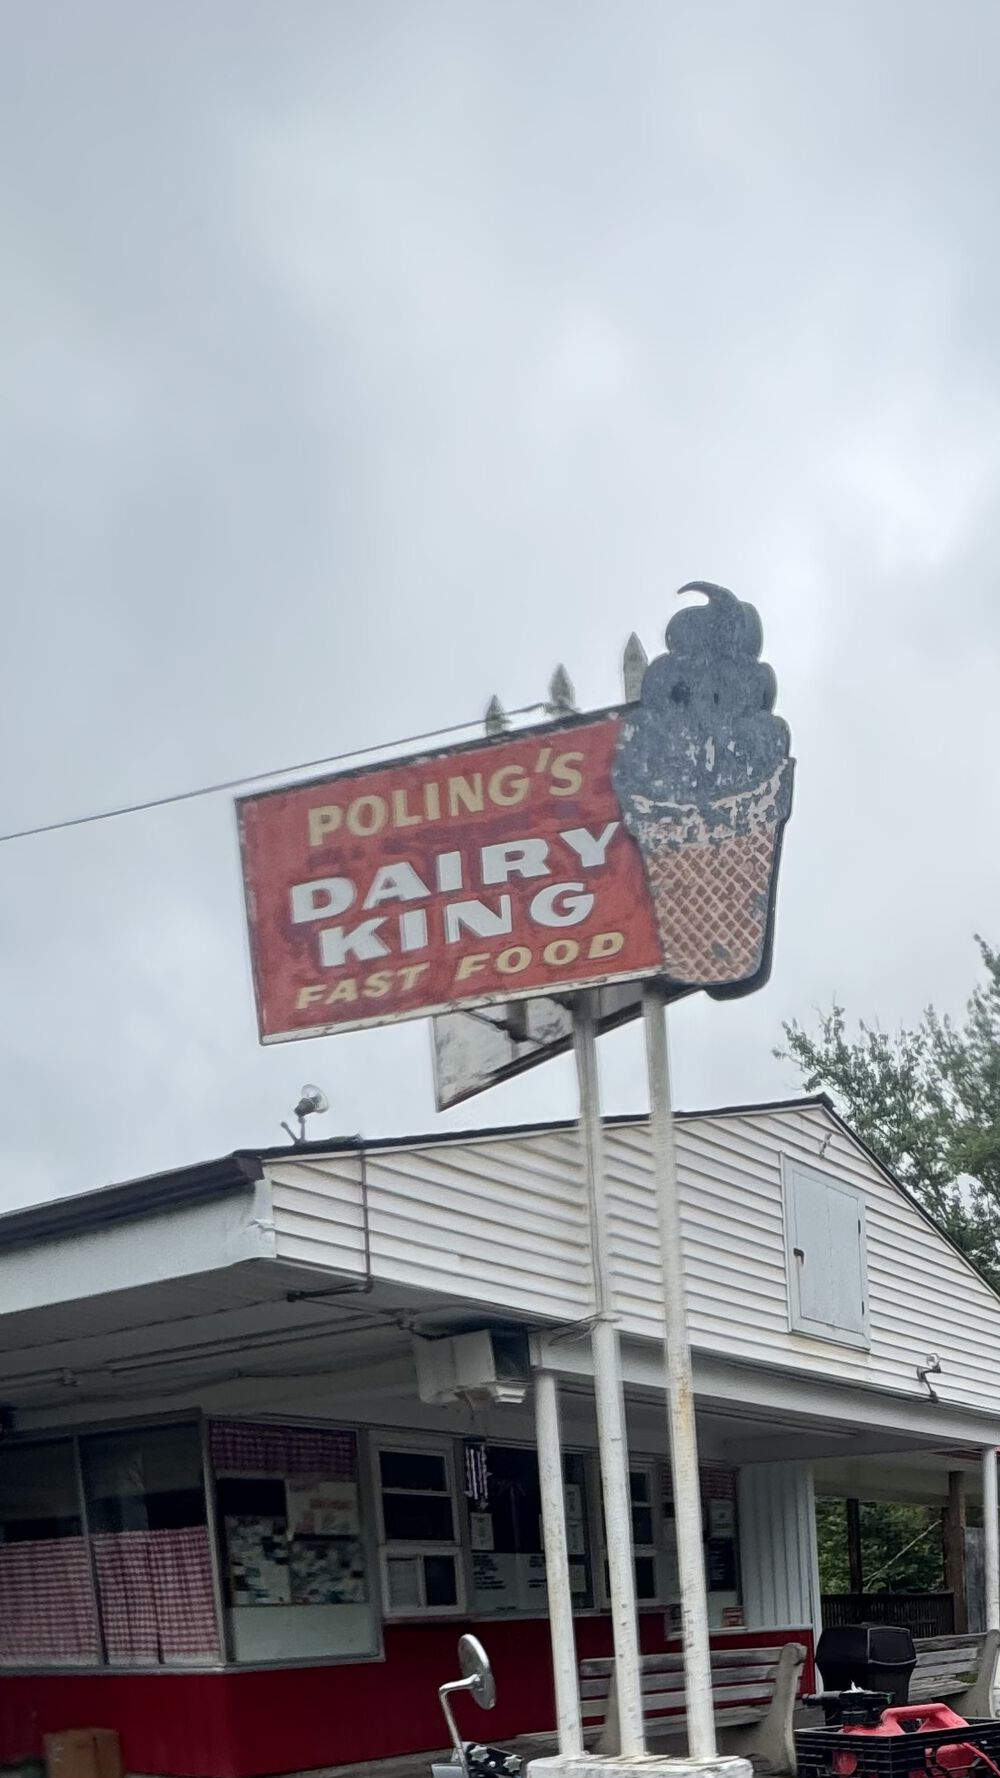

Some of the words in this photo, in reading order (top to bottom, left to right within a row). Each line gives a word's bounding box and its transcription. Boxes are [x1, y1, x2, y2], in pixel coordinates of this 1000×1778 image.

[308, 747, 584, 847] POLING'S
[290, 821, 620, 924] DAIRY
[295, 962, 430, 1009] FAST
[454, 931, 625, 981] FOOD
[319, 882, 594, 968] KING
